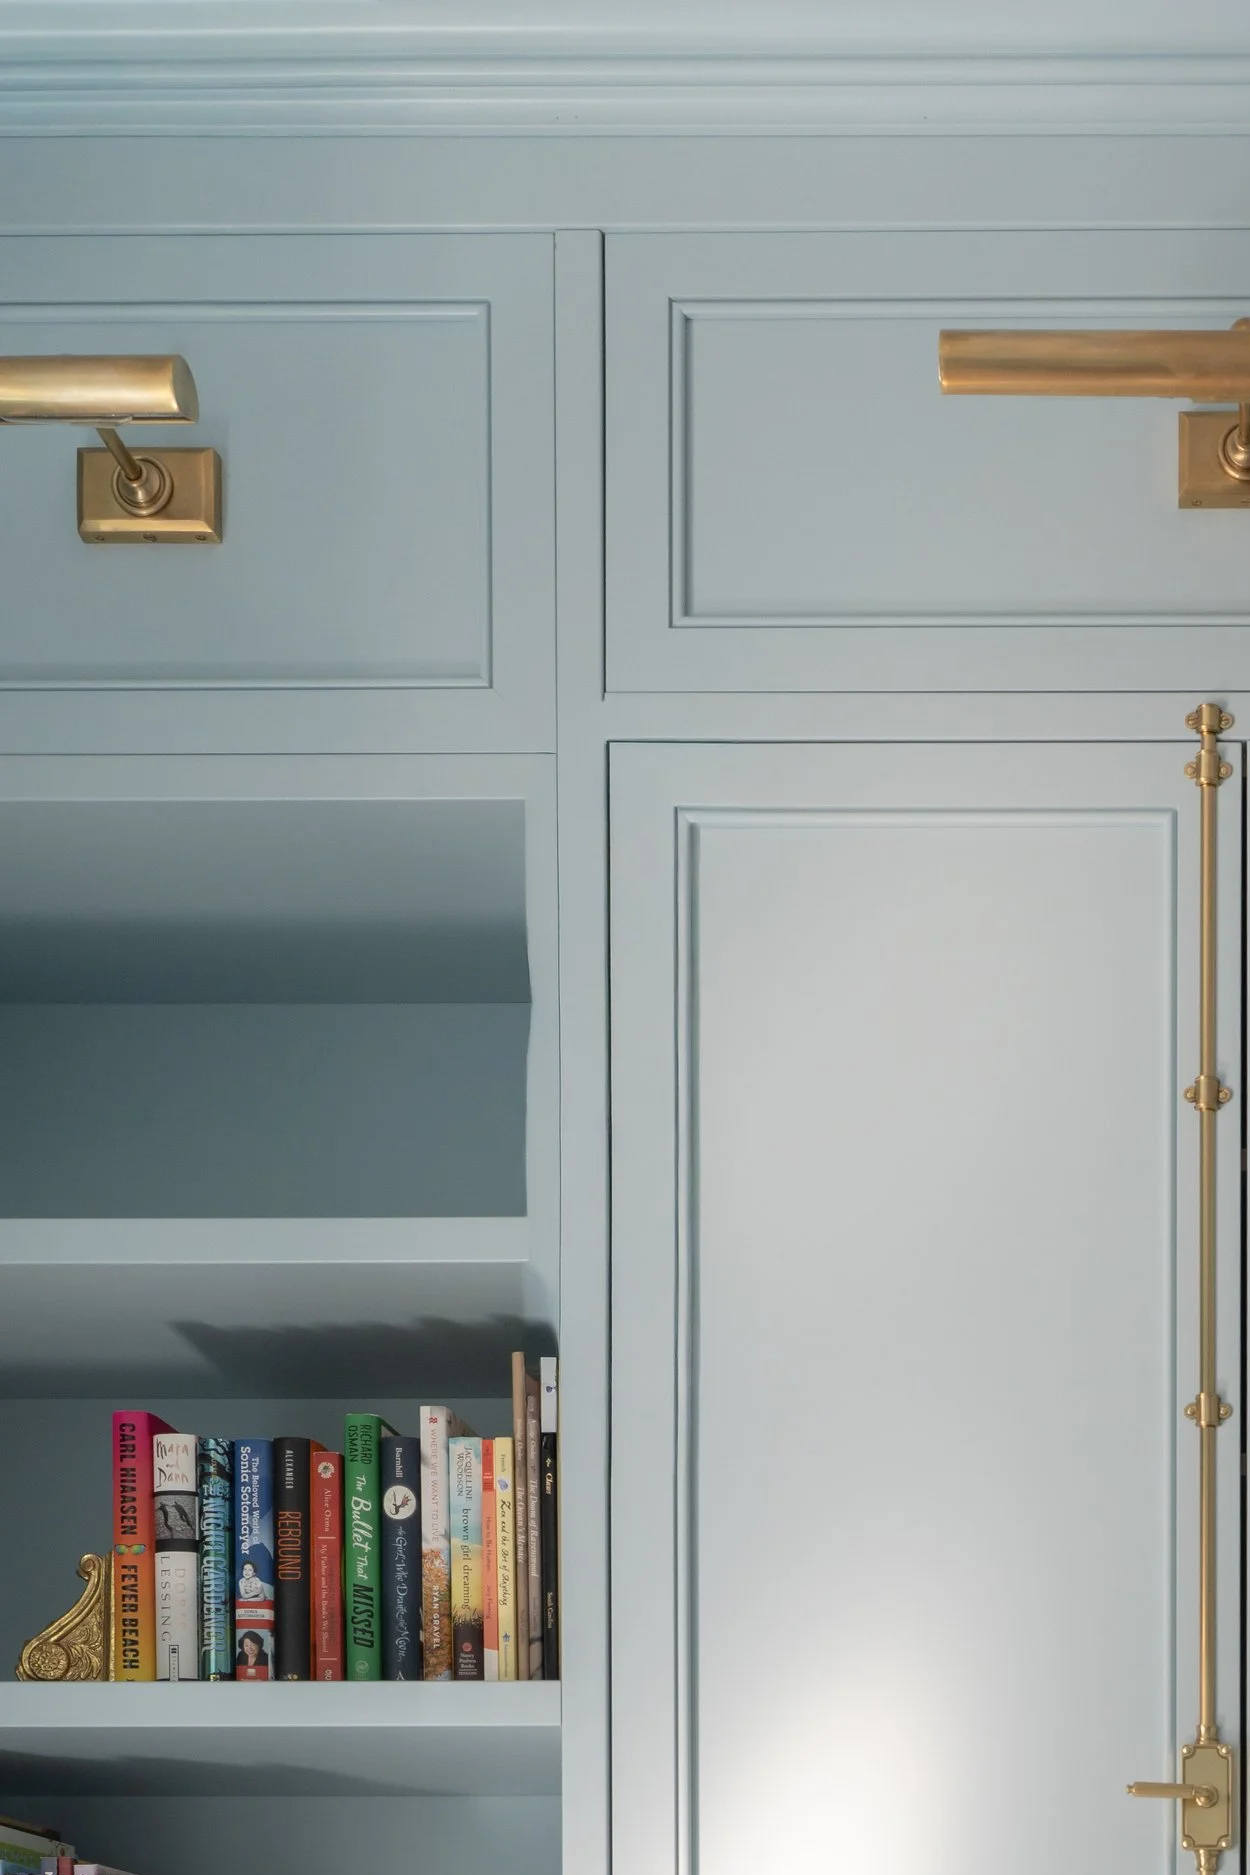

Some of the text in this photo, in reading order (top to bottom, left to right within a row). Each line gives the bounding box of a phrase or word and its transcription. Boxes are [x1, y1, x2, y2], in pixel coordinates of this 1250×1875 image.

[156, 1438, 189, 1459] Mara
[252, 1457, 260, 1473] The
[348, 1425, 358, 1463] OSMAN
[360, 1424, 372, 1465] RICHARD
[395, 1448, 403, 1478] Barnhill
[430, 1429, 438, 1462] WHERE
[119, 1423, 137, 1535] CARL HIAASEN
[156, 1467, 189, 1488] Dann
[252, 1475, 260, 1507] Beloved
[285, 1450, 294, 1489] ALEXANDER
[431, 1464, 438, 1479] WE
[464, 1447, 473, 1501] JACQUELINE
[240, 1447, 251, 1555] Sonia Sotomayor
[252, 1510, 260, 1535] World
[324, 1489, 332, 1532] Alice Ozma
[201, 1499, 226, 1551] NIGHT
[278, 1511, 301, 1580] REBOUND
[351, 1475, 375, 1649] The Bullet That MISSED
[460, 1508, 472, 1611] brown girl dreaming
[121, 1565, 139, 1669] FEVER BEACH
[160, 1555, 172, 1642] LESSING
[202, 1556, 227, 1653] GARDENER
[432, 1585, 441, 1649] RYAN GRAVEL
